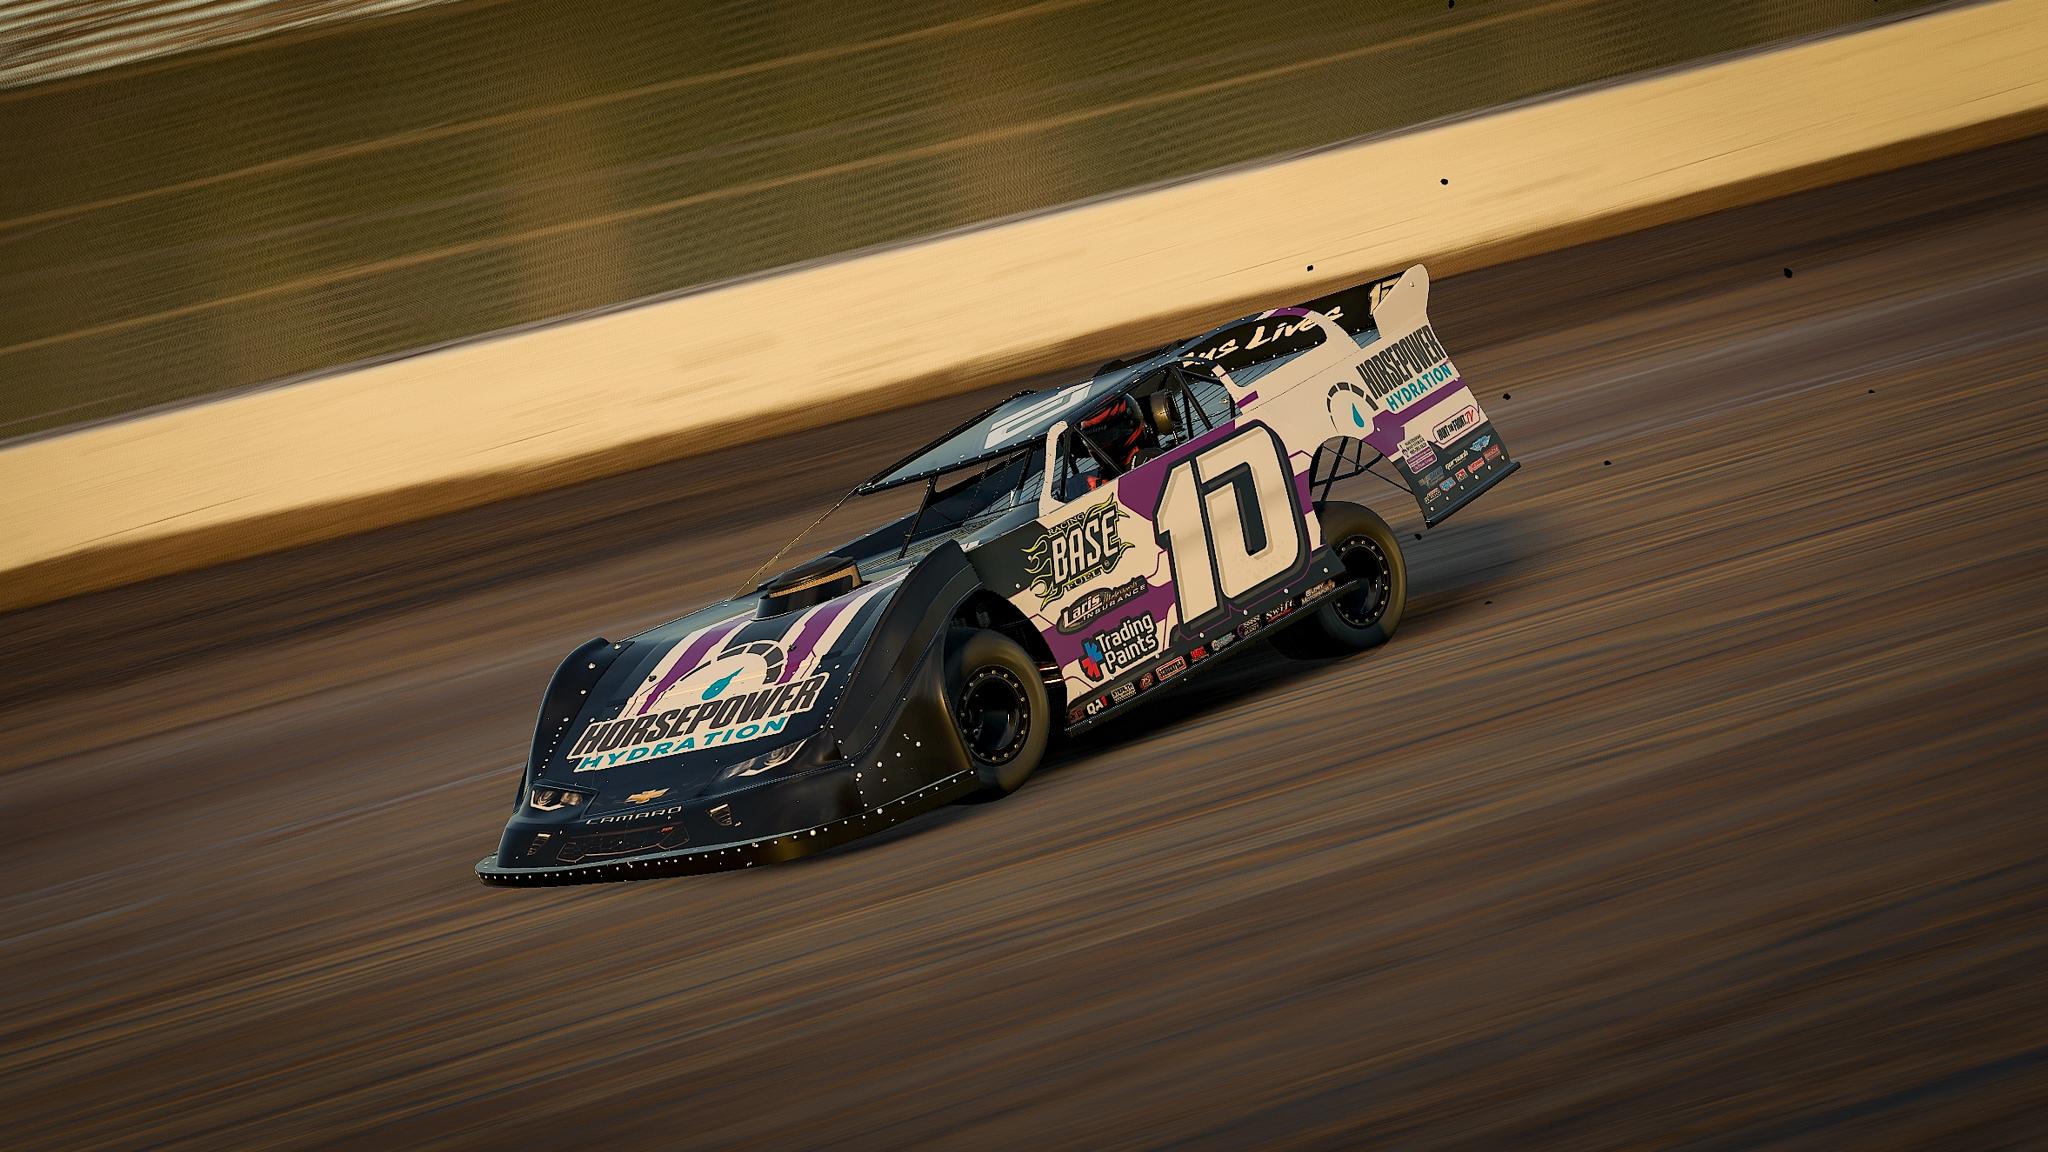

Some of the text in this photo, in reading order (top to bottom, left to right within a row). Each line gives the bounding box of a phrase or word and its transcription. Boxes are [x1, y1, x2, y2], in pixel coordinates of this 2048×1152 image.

[1356, 325, 1446, 400] HORSEPOWER
[1386, 363, 1453, 411] HYDRATION
[1048, 511, 1086, 536] RACING
[1156, 425, 1300, 625] 10
[1051, 508, 1119, 585] BASE
[1066, 568, 1102, 591] FUEL
[1063, 593, 1103, 628] Laris
[1083, 584, 1146, 620] INSURANCE
[1265, 600, 1294, 619] Swift
[1095, 614, 1155, 653] Trading
[1104, 633, 1156, 670] Paints
[571, 676, 825, 757] HORSEPOWER
[1086, 695, 1108, 715] QA1
[578, 716, 788, 770] HYDRATION
[585, 805, 682, 825] CAMARO
